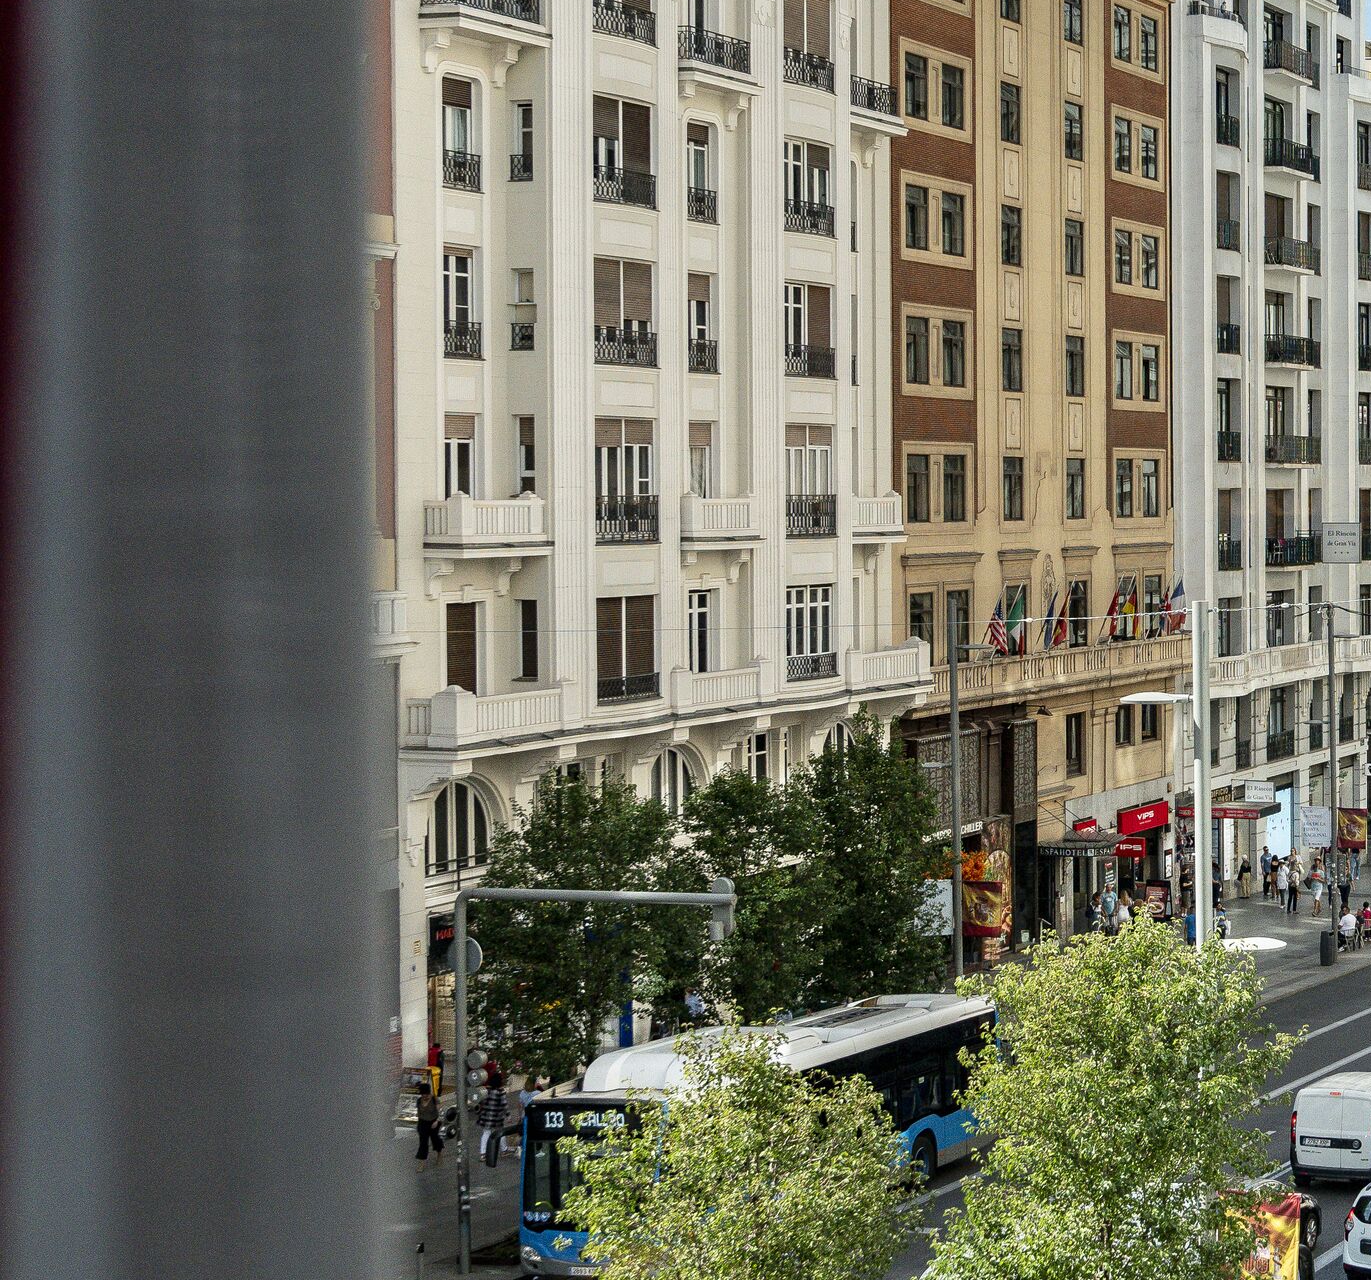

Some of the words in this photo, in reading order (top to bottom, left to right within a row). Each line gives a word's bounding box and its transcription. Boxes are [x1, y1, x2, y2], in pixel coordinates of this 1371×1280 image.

[1137, 810, 1155, 820] VIPS
[960, 821, 984, 834] CHILLER
[544, 1111, 565, 1128] 133
